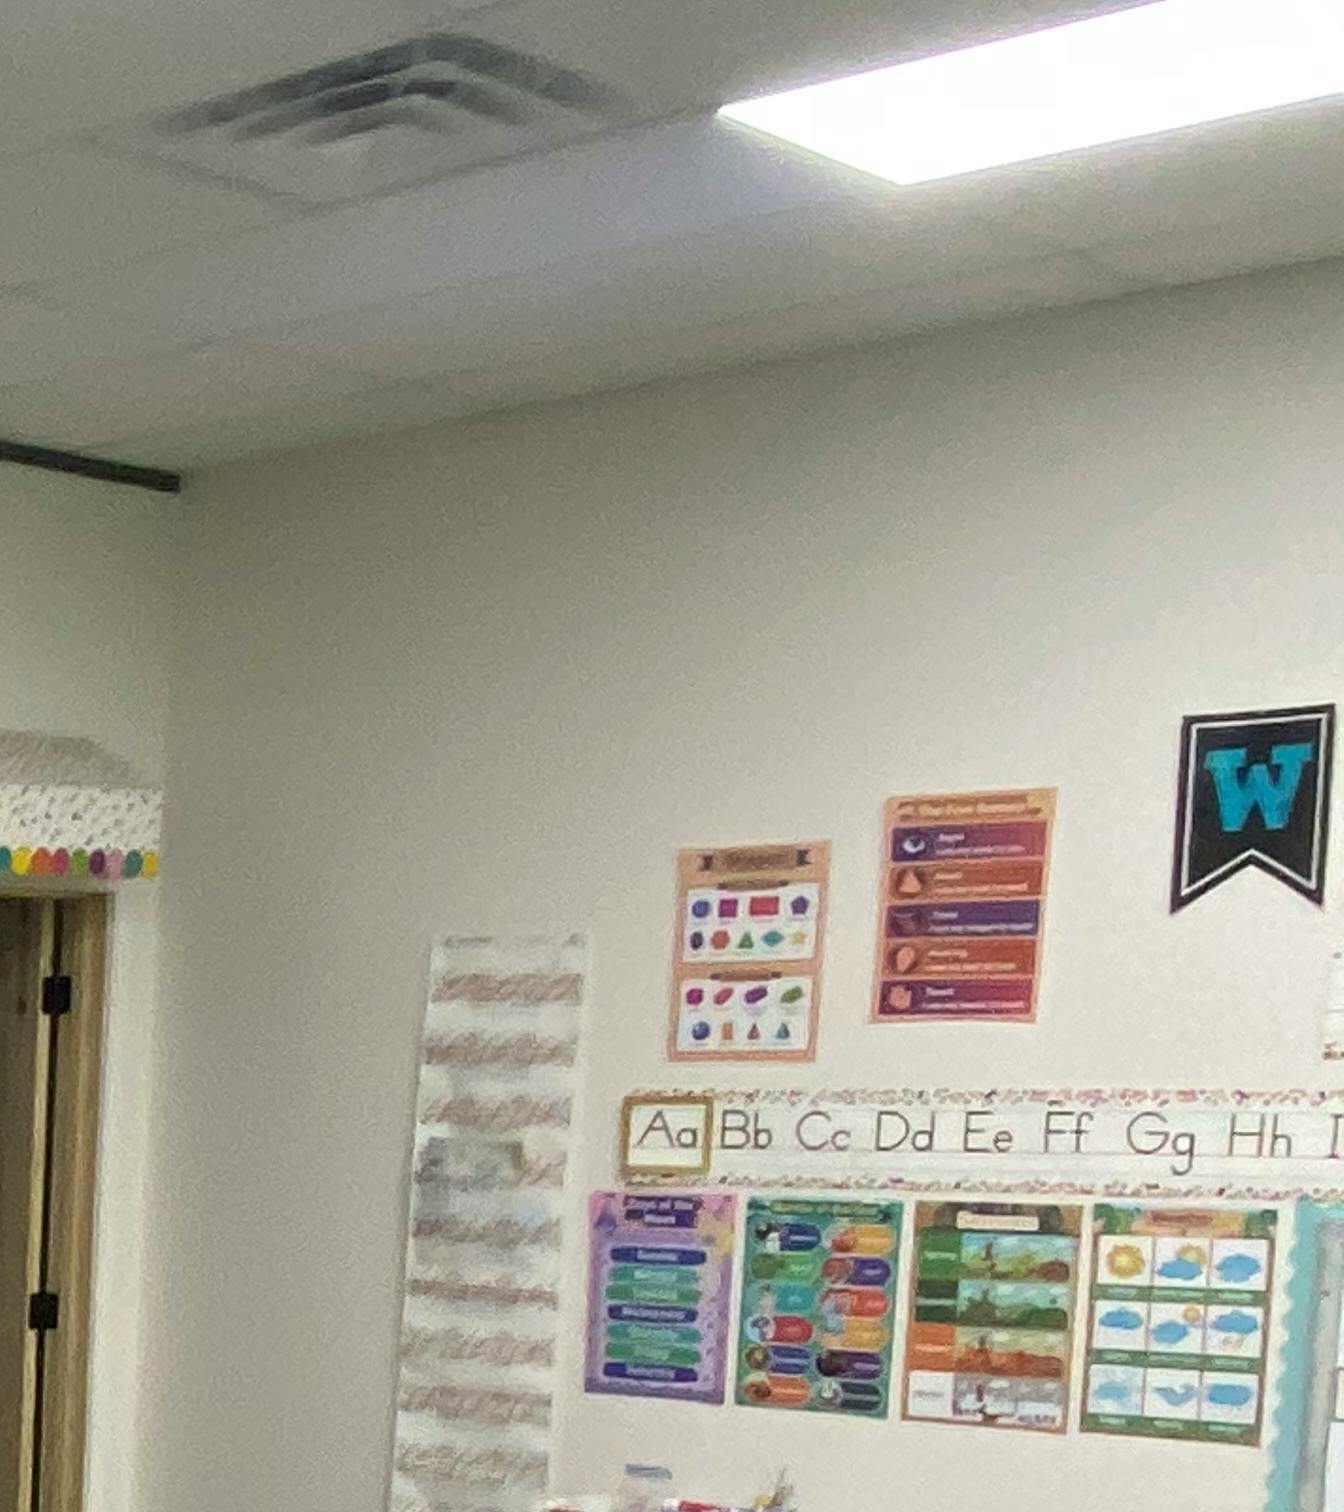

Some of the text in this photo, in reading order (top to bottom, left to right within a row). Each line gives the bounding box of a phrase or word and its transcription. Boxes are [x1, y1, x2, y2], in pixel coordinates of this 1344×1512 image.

[1203, 743, 1312, 831] W
[635, 1110, 699, 1149] Aa
[720, 1110, 773, 1150] Bb
[795, 1110, 852, 1152] Cc
[875, 1111, 936, 1152] Dd
[963, 1111, 1013, 1153] Ee
[1043, 1111, 1094, 1154] Ff
[1126, 1111, 1196, 1176] Gg
[1227, 1112, 1293, 1158] Hh
